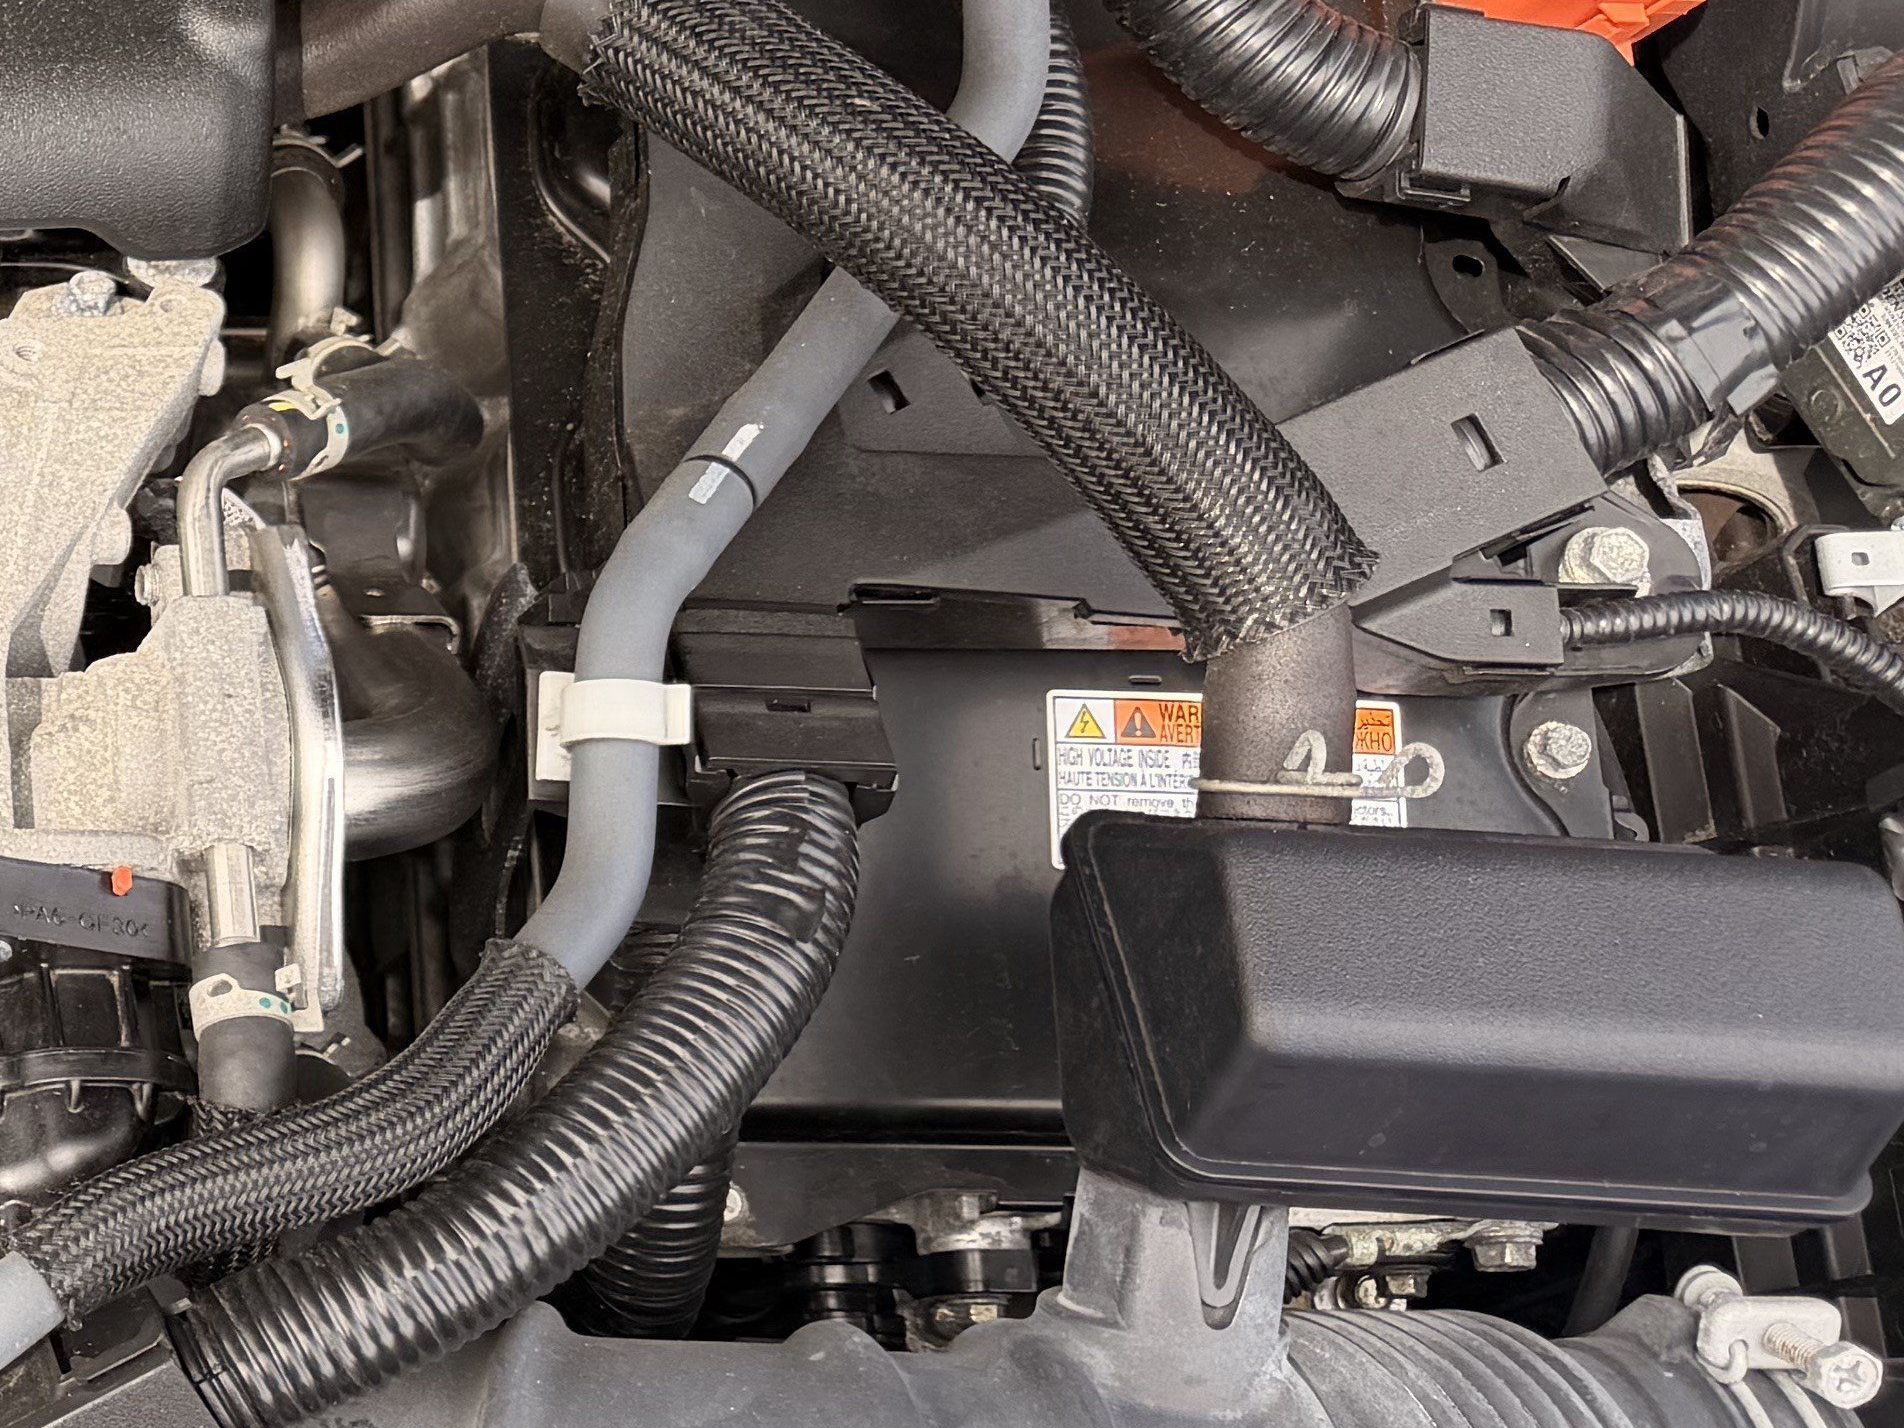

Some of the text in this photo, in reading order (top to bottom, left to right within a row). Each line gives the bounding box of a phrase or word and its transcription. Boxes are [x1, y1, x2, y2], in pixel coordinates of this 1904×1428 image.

[1058, 746, 1083, 767] HIGH
[1089, 747, 1135, 768] VOLTAGE
[1138, 748, 1170, 769] INSIDE
[1058, 770, 1092, 787] HAUTE
[1094, 771, 1139, 788] TENSION
[1059, 792, 1081, 806] DO
[1089, 793, 1119, 807] NOT
[1127, 795, 1175, 808] remove
